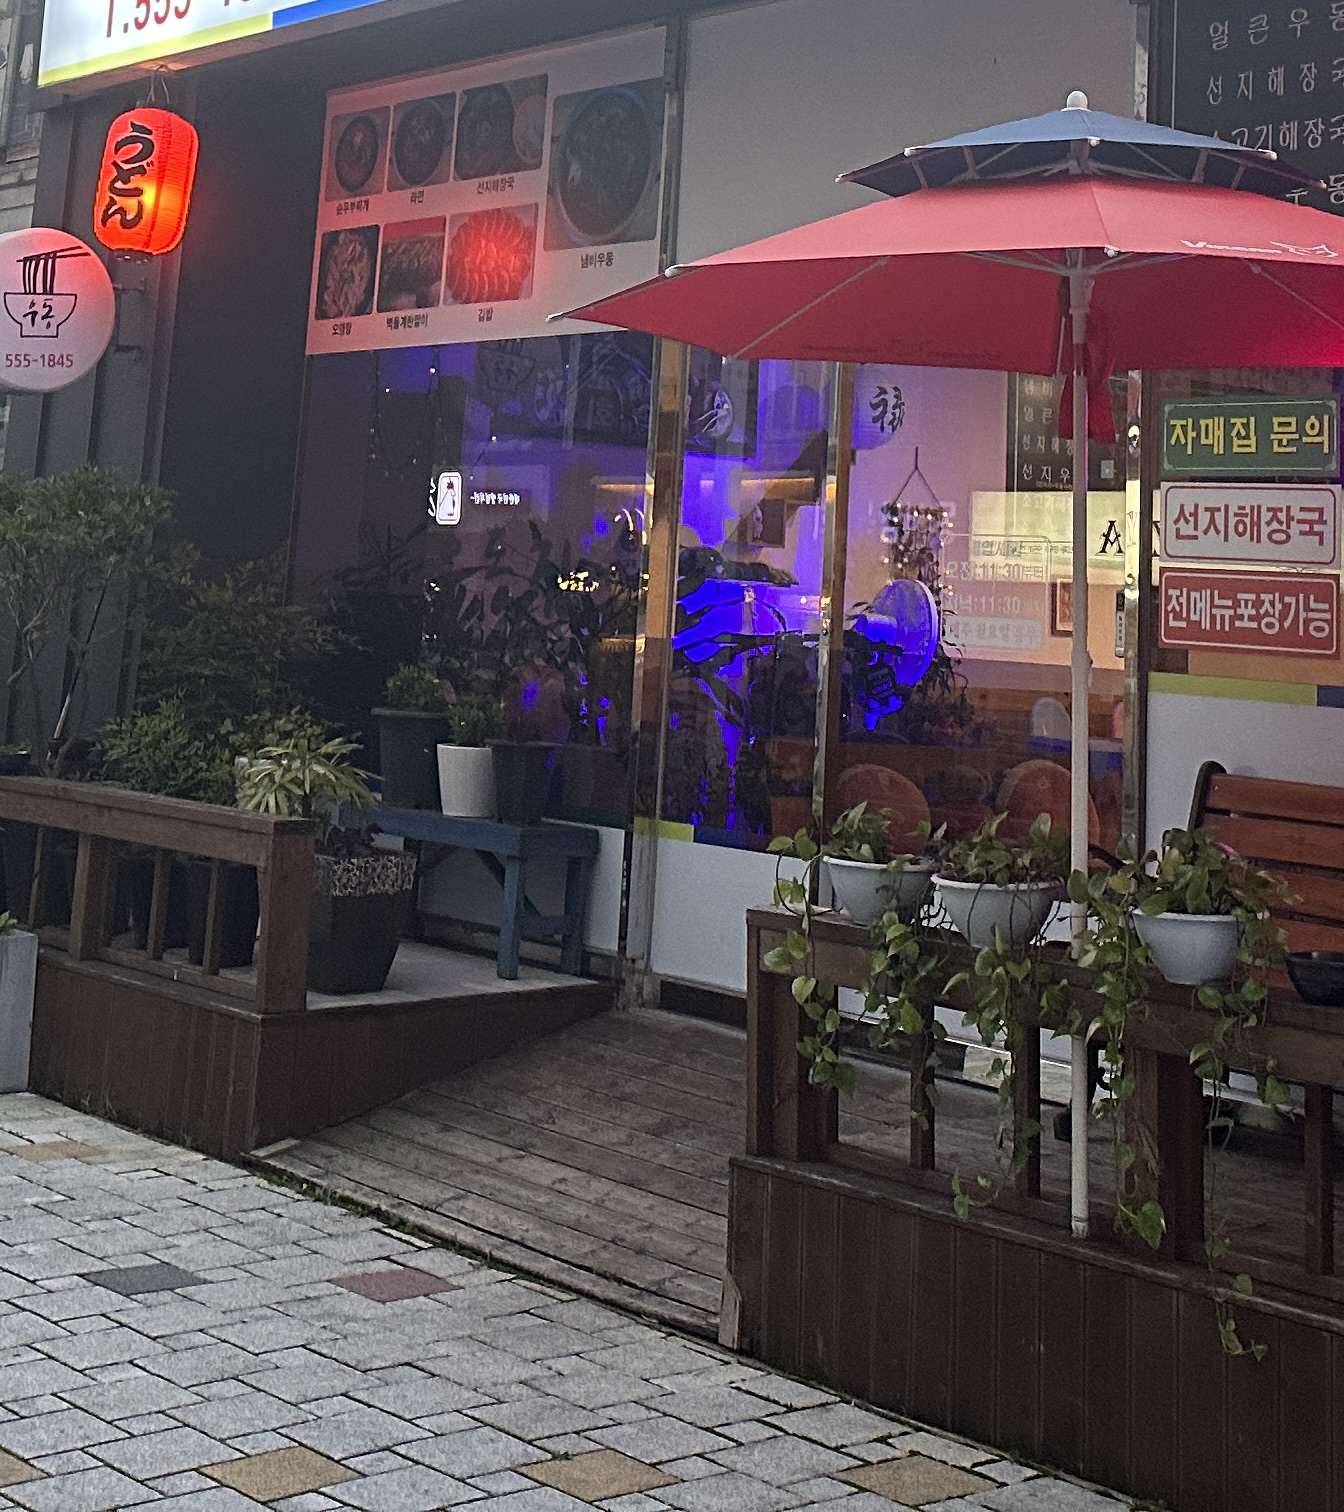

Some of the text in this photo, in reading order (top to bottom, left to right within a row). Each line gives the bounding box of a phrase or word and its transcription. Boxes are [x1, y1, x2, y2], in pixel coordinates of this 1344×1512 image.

[100, 120, 156, 230] うどん
[5, 353, 74, 369] 555-1845
[1169, 413, 1331, 455] 자매집 문의
[1172, 502, 1328, 547] 선지해장국
[1166, 587, 1332, 640] 전메뉴포장가능
